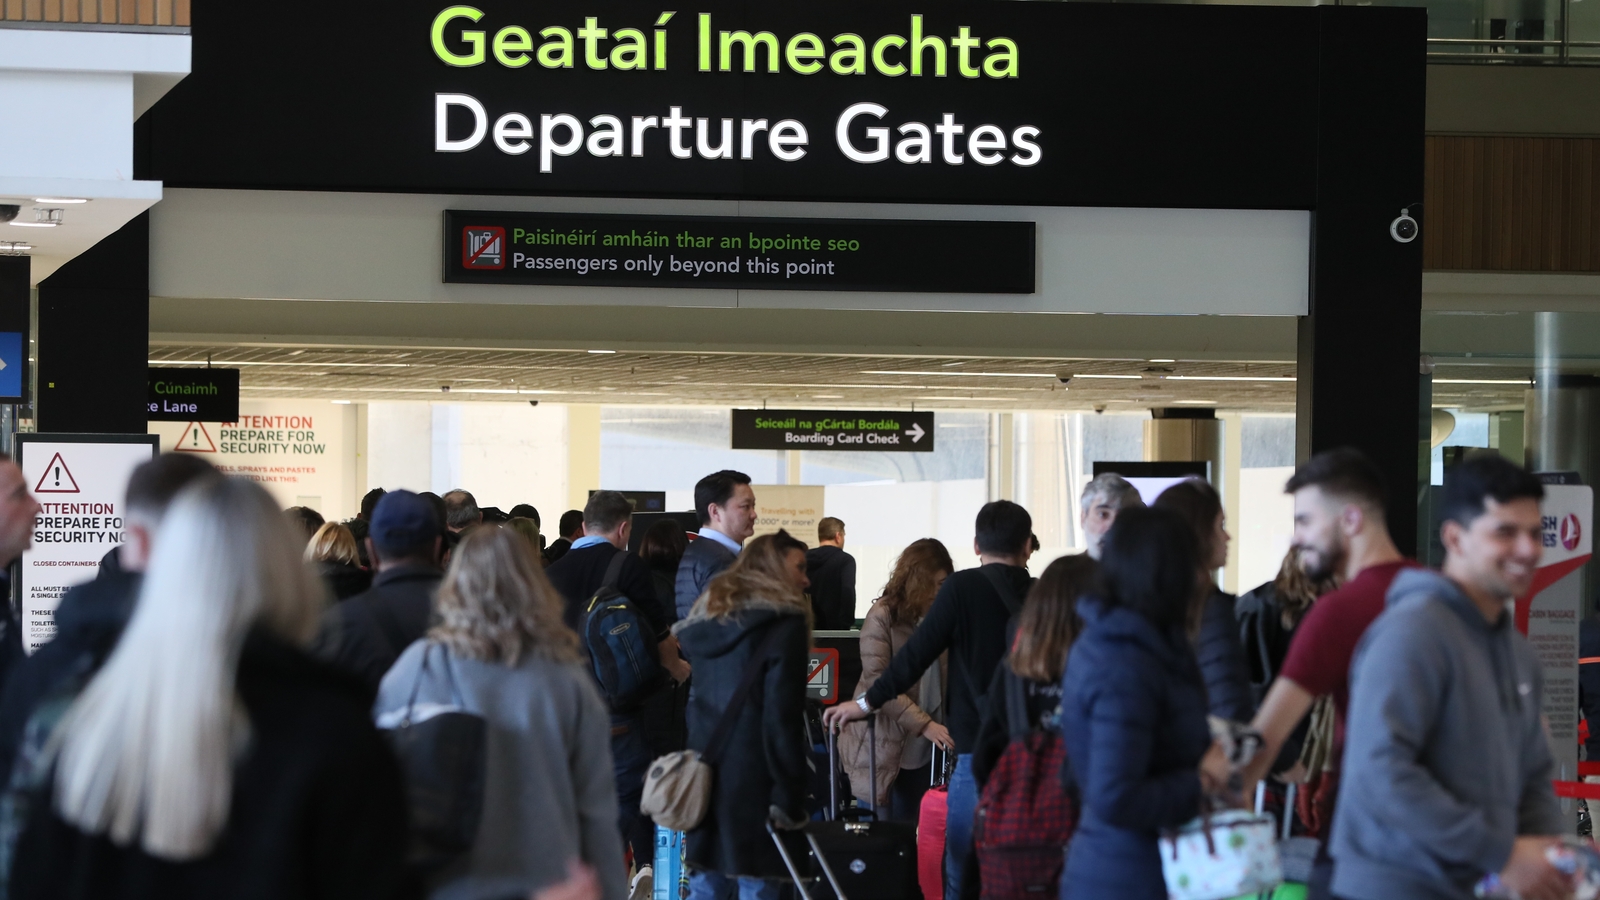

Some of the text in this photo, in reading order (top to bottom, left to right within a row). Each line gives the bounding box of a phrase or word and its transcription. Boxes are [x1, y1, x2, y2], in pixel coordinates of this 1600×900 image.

[431, 5, 1020, 79] Geataí Imeachta
[435, 92, 1042, 173] Departure Gates
[513, 228, 860, 253] Paisinéirí amháin thar an bpointe seo
[513, 253, 835, 278] Passengers only beyond this point
[154, 381, 218, 395] Cúnaimh
[164, 400, 198, 413] Lane
[755, 418, 900, 431] Seiceáil na gCártaí Bordála
[220, 430, 315, 442] PREPARE FOR
[785, 432, 900, 446] Boarding Card Check
[220, 442, 326, 455] SECURITY NOW
[237, 465, 268, 473] SPRAYS
[35, 517, 126, 529] PREPARE FO
[34, 531, 127, 543] SECURITY NO
